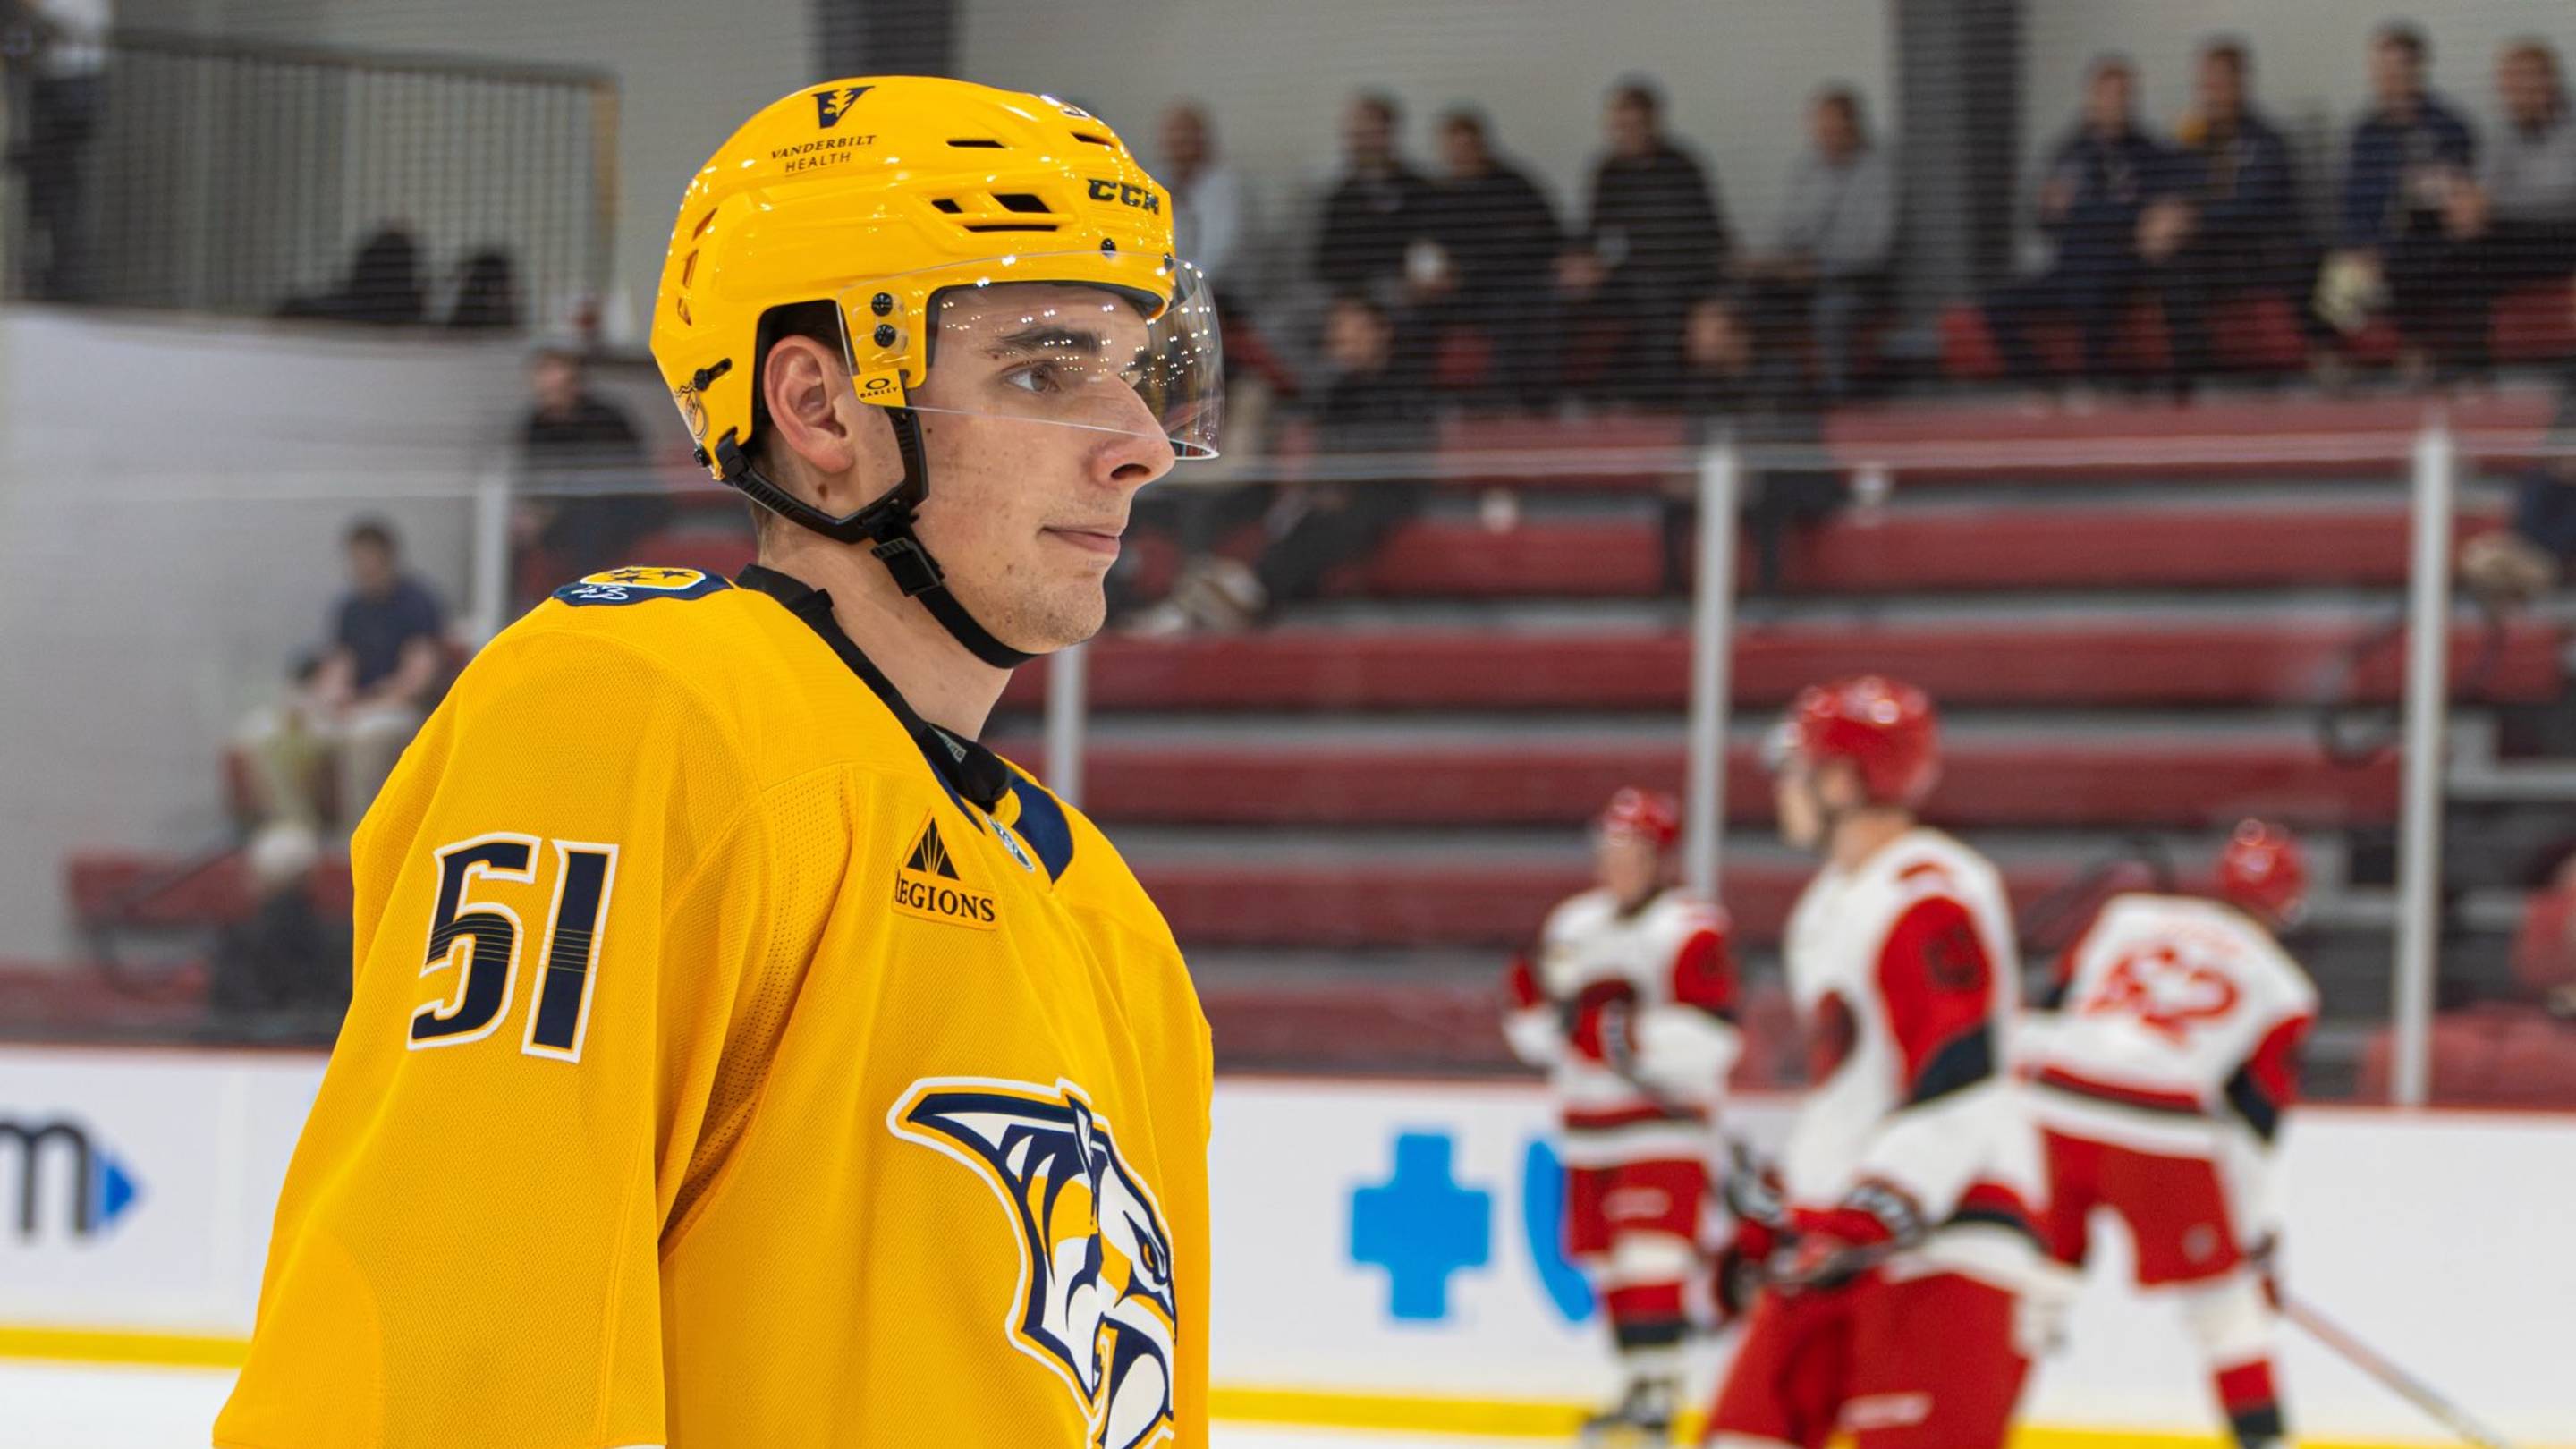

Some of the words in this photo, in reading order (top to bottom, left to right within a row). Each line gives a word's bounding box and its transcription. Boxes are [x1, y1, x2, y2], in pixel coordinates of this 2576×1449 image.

[771, 135, 877, 159] VANDERBILT
[785, 151, 852, 173] HEALTH
[1087, 178, 1160, 216] CCM
[405, 832, 619, 1064] 51
